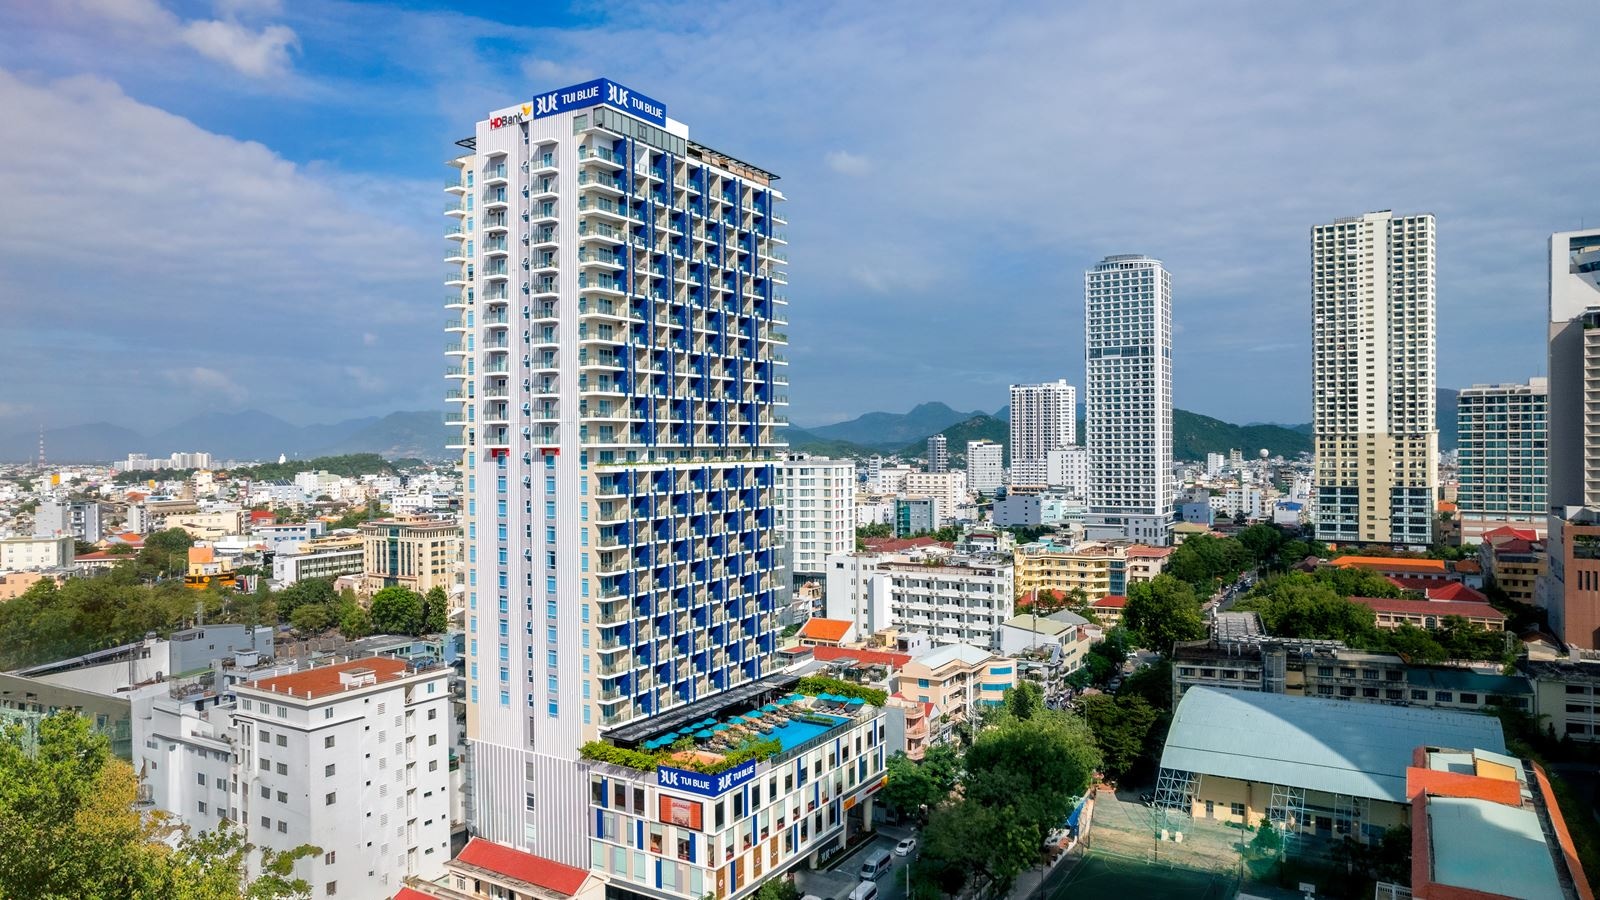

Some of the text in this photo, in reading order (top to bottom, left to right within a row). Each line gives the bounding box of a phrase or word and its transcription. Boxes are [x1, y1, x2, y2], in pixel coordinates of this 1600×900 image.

[561, 92, 575, 104] TUI
[577, 86, 599, 100] BLUE
[631, 97, 644, 110] TUI
[644, 103, 663, 119] BLUE
[490, 112, 523, 129] HDBank
[733, 771, 742, 781] TUI
[741, 765, 754, 778] BLUE
[680, 776, 692, 786] TUI
[692, 779, 710, 790] BLUE
